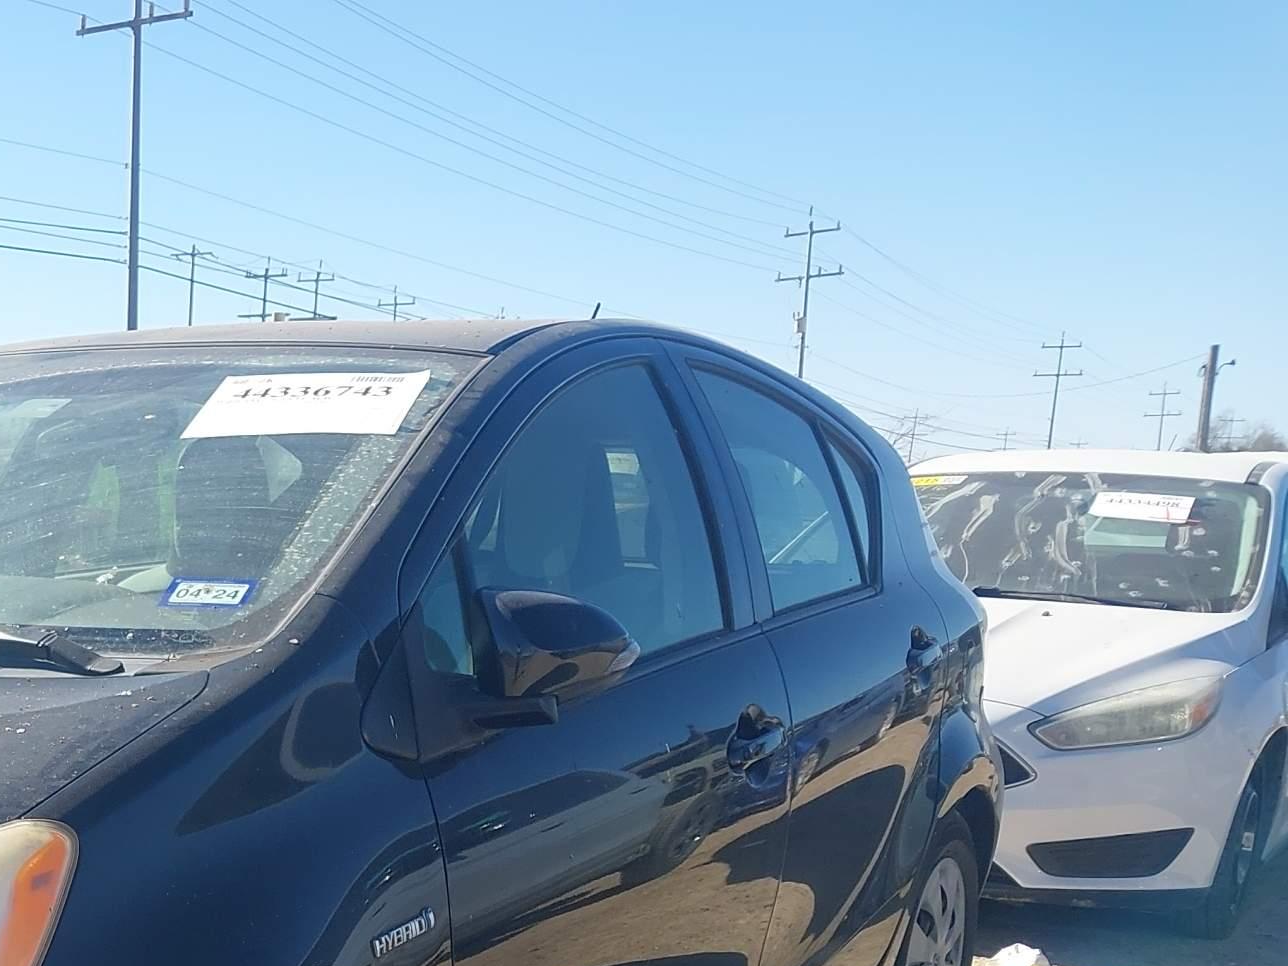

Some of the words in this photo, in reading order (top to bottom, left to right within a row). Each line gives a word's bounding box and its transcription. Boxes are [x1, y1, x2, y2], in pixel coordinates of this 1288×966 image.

[233, 386, 393, 399] 44336743
[175, 588, 203, 599] 04
[211, 589, 240, 600] 24
[372, 914, 427, 958] HYBRID
